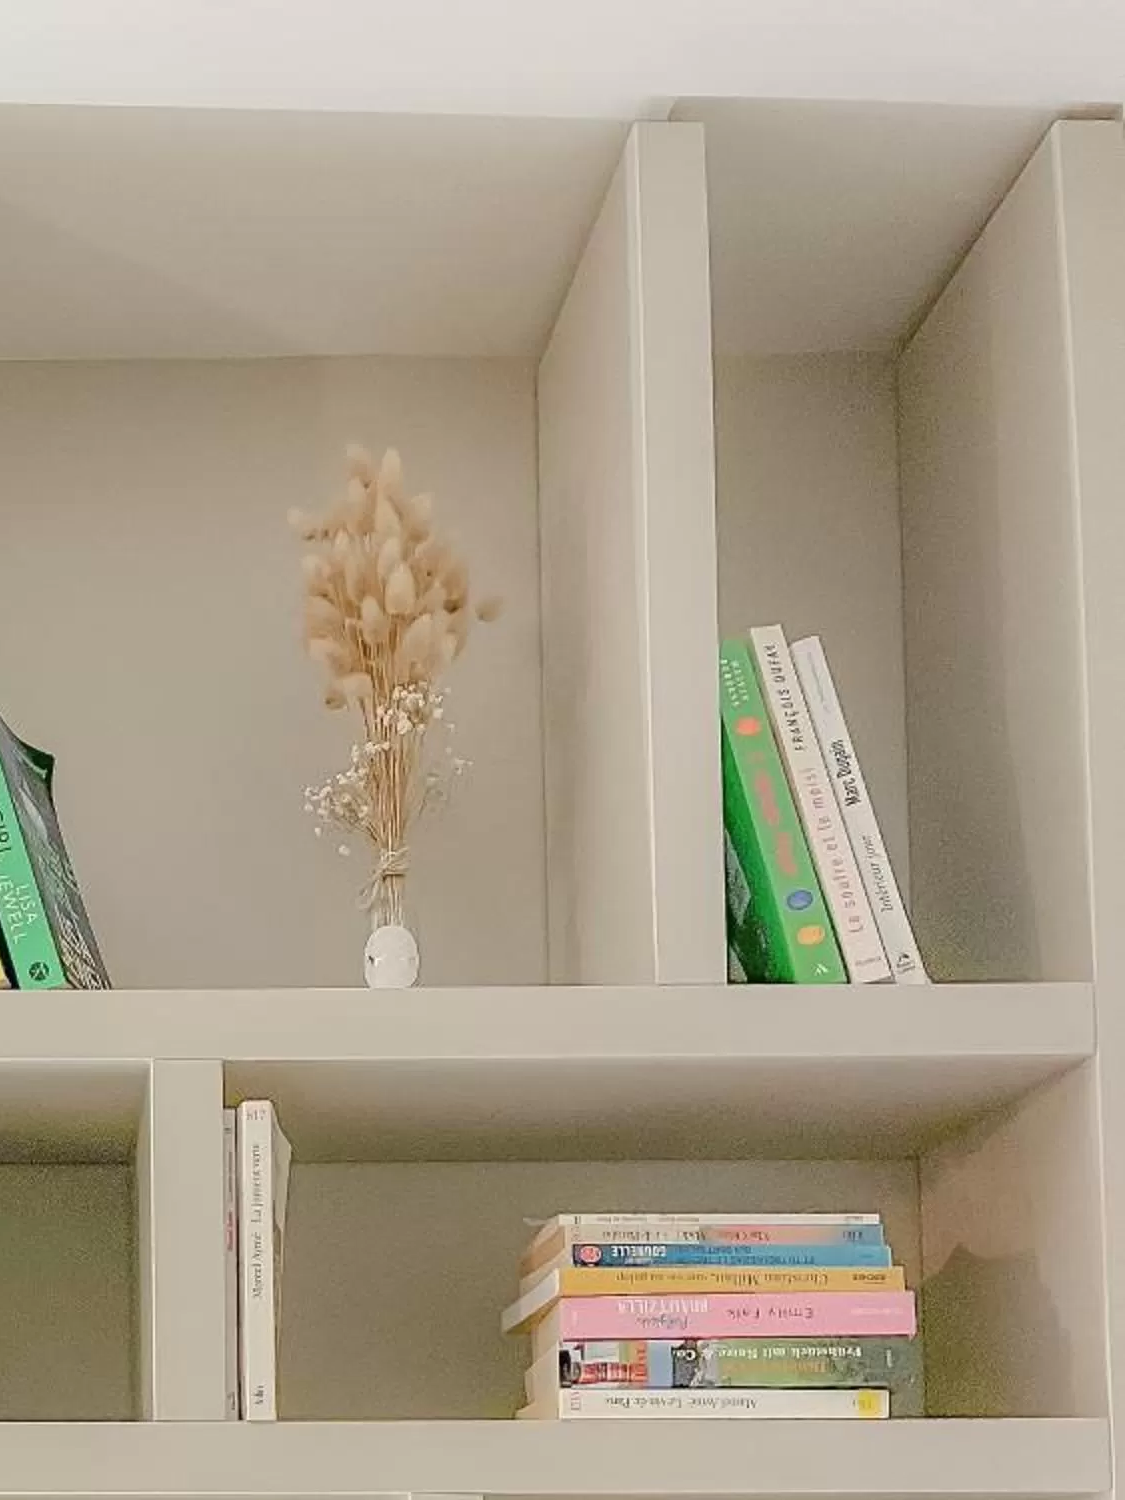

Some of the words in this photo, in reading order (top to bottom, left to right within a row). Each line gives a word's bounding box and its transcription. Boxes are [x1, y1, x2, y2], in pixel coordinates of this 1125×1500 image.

[841, 776, 861, 808] Marc
[13, 883, 34, 925] LISA
[610, 1245, 667, 1257] GOUNELLE
[764, 1273, 828, 1285] Christian
[725, 1308, 761, 1320] Falk
[769, 1306, 813, 1320] Emily
[671, 1349, 697, 1361] Co.
[789, 1345, 862, 1358] Frühstück
